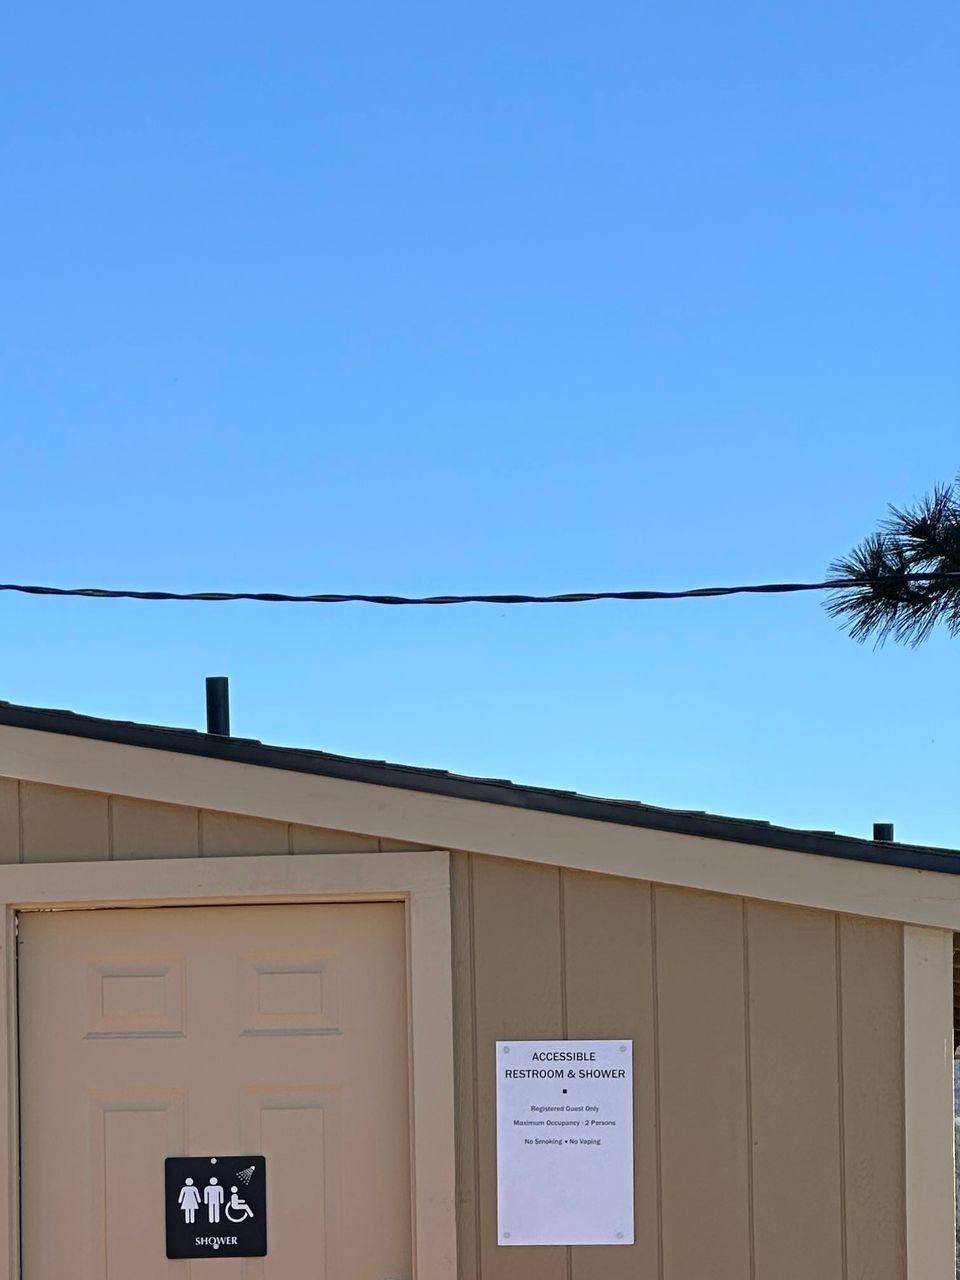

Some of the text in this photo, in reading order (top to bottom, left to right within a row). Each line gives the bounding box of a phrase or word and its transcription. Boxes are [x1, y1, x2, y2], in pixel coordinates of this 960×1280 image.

[531, 1052, 596, 1062] ACCESSIBLE
[505, 1069, 626, 1079] RESTROOM & SHOWER
[530, 1105, 564, 1113] Registered
[585, 1105, 599, 1113] Only
[513, 1119, 545, 1127] Maximum
[546, 1119, 580, 1127] Occupancy
[584, 1119, 590, 1127] 2
[590, 1119, 616, 1127] Persons
[524, 1138, 601, 1147] No Smoking No Vaping
[195, 1236, 238, 1246] SHOWER
